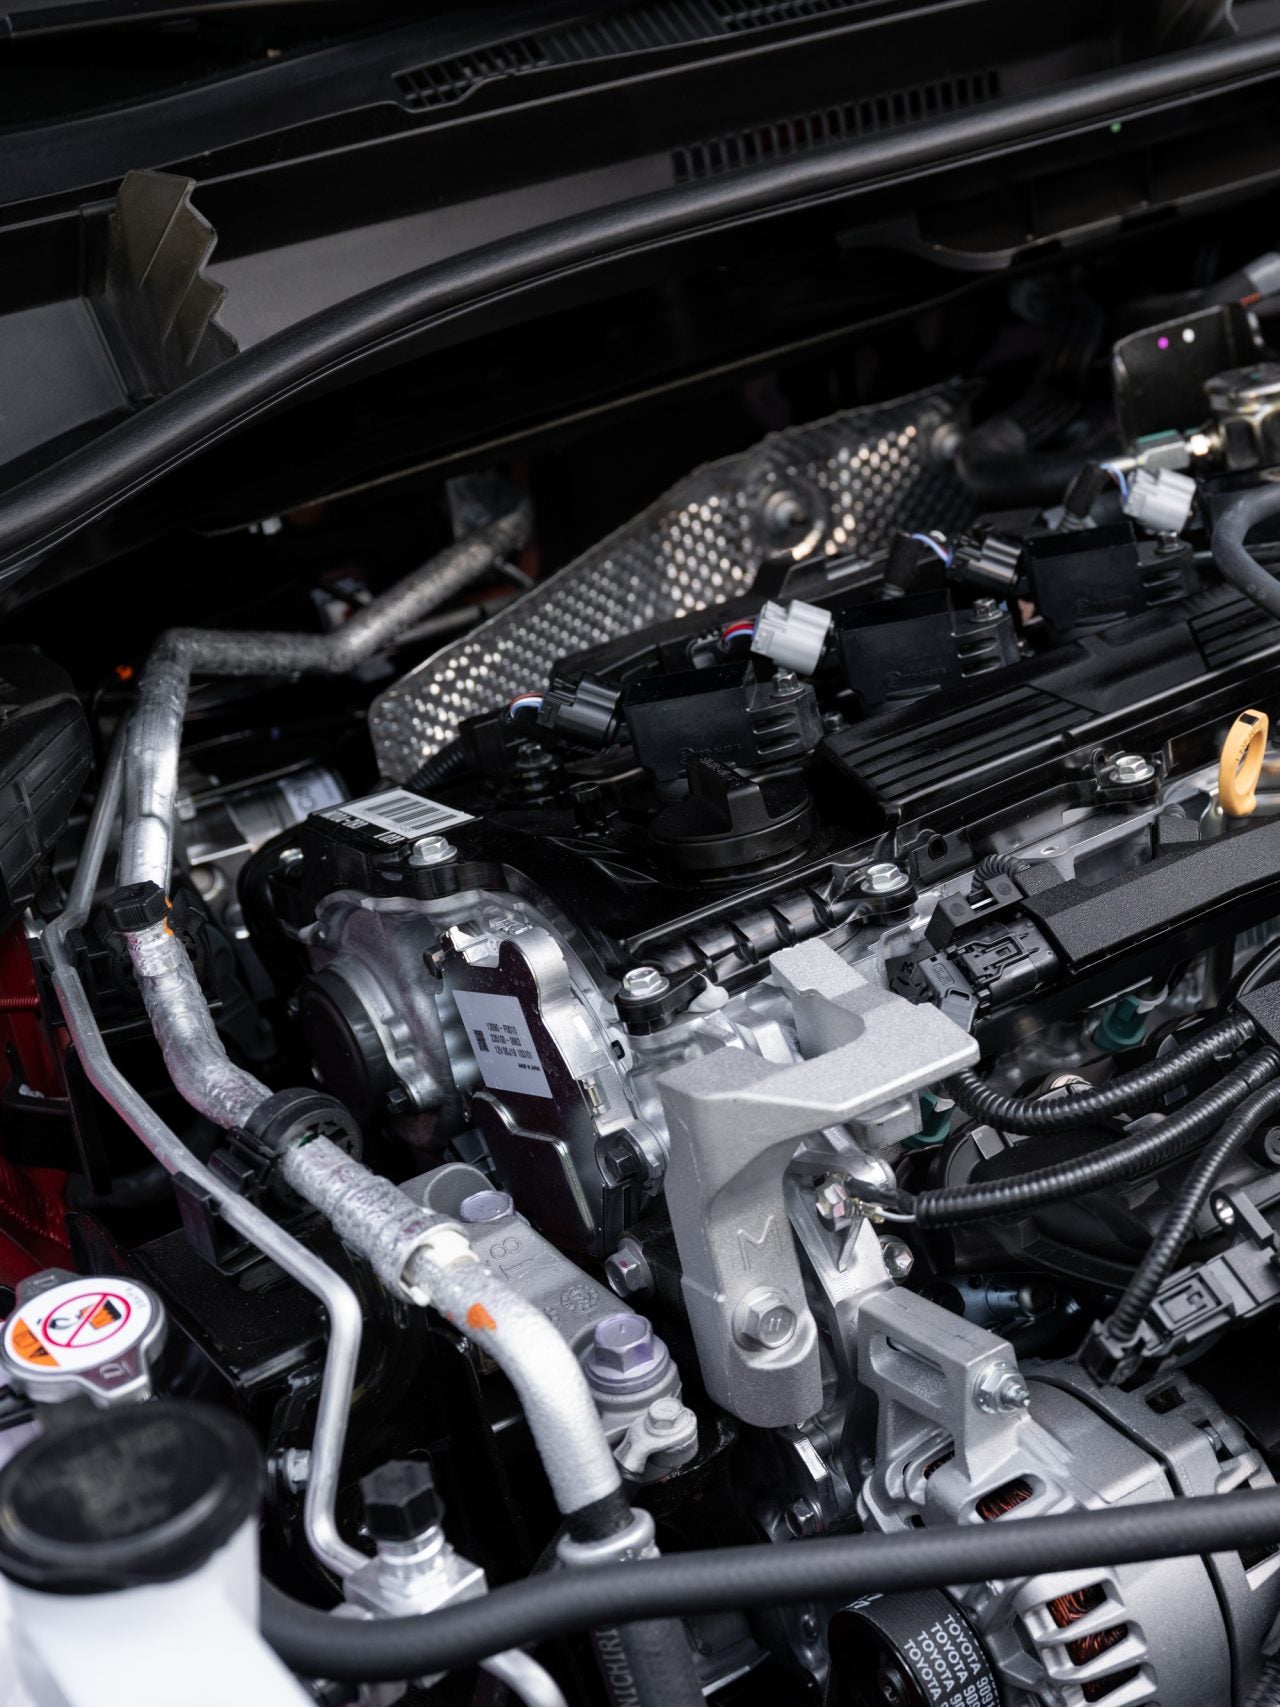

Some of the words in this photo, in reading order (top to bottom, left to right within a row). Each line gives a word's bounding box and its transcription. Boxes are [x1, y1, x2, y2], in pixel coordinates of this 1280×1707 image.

[904, 1638, 942, 1701] TOYOTA
[917, 1630, 955, 1692] TOYOTA
[930, 1622, 968, 1684] TOYOTA
[944, 1613, 981, 1676] TOYOTA
